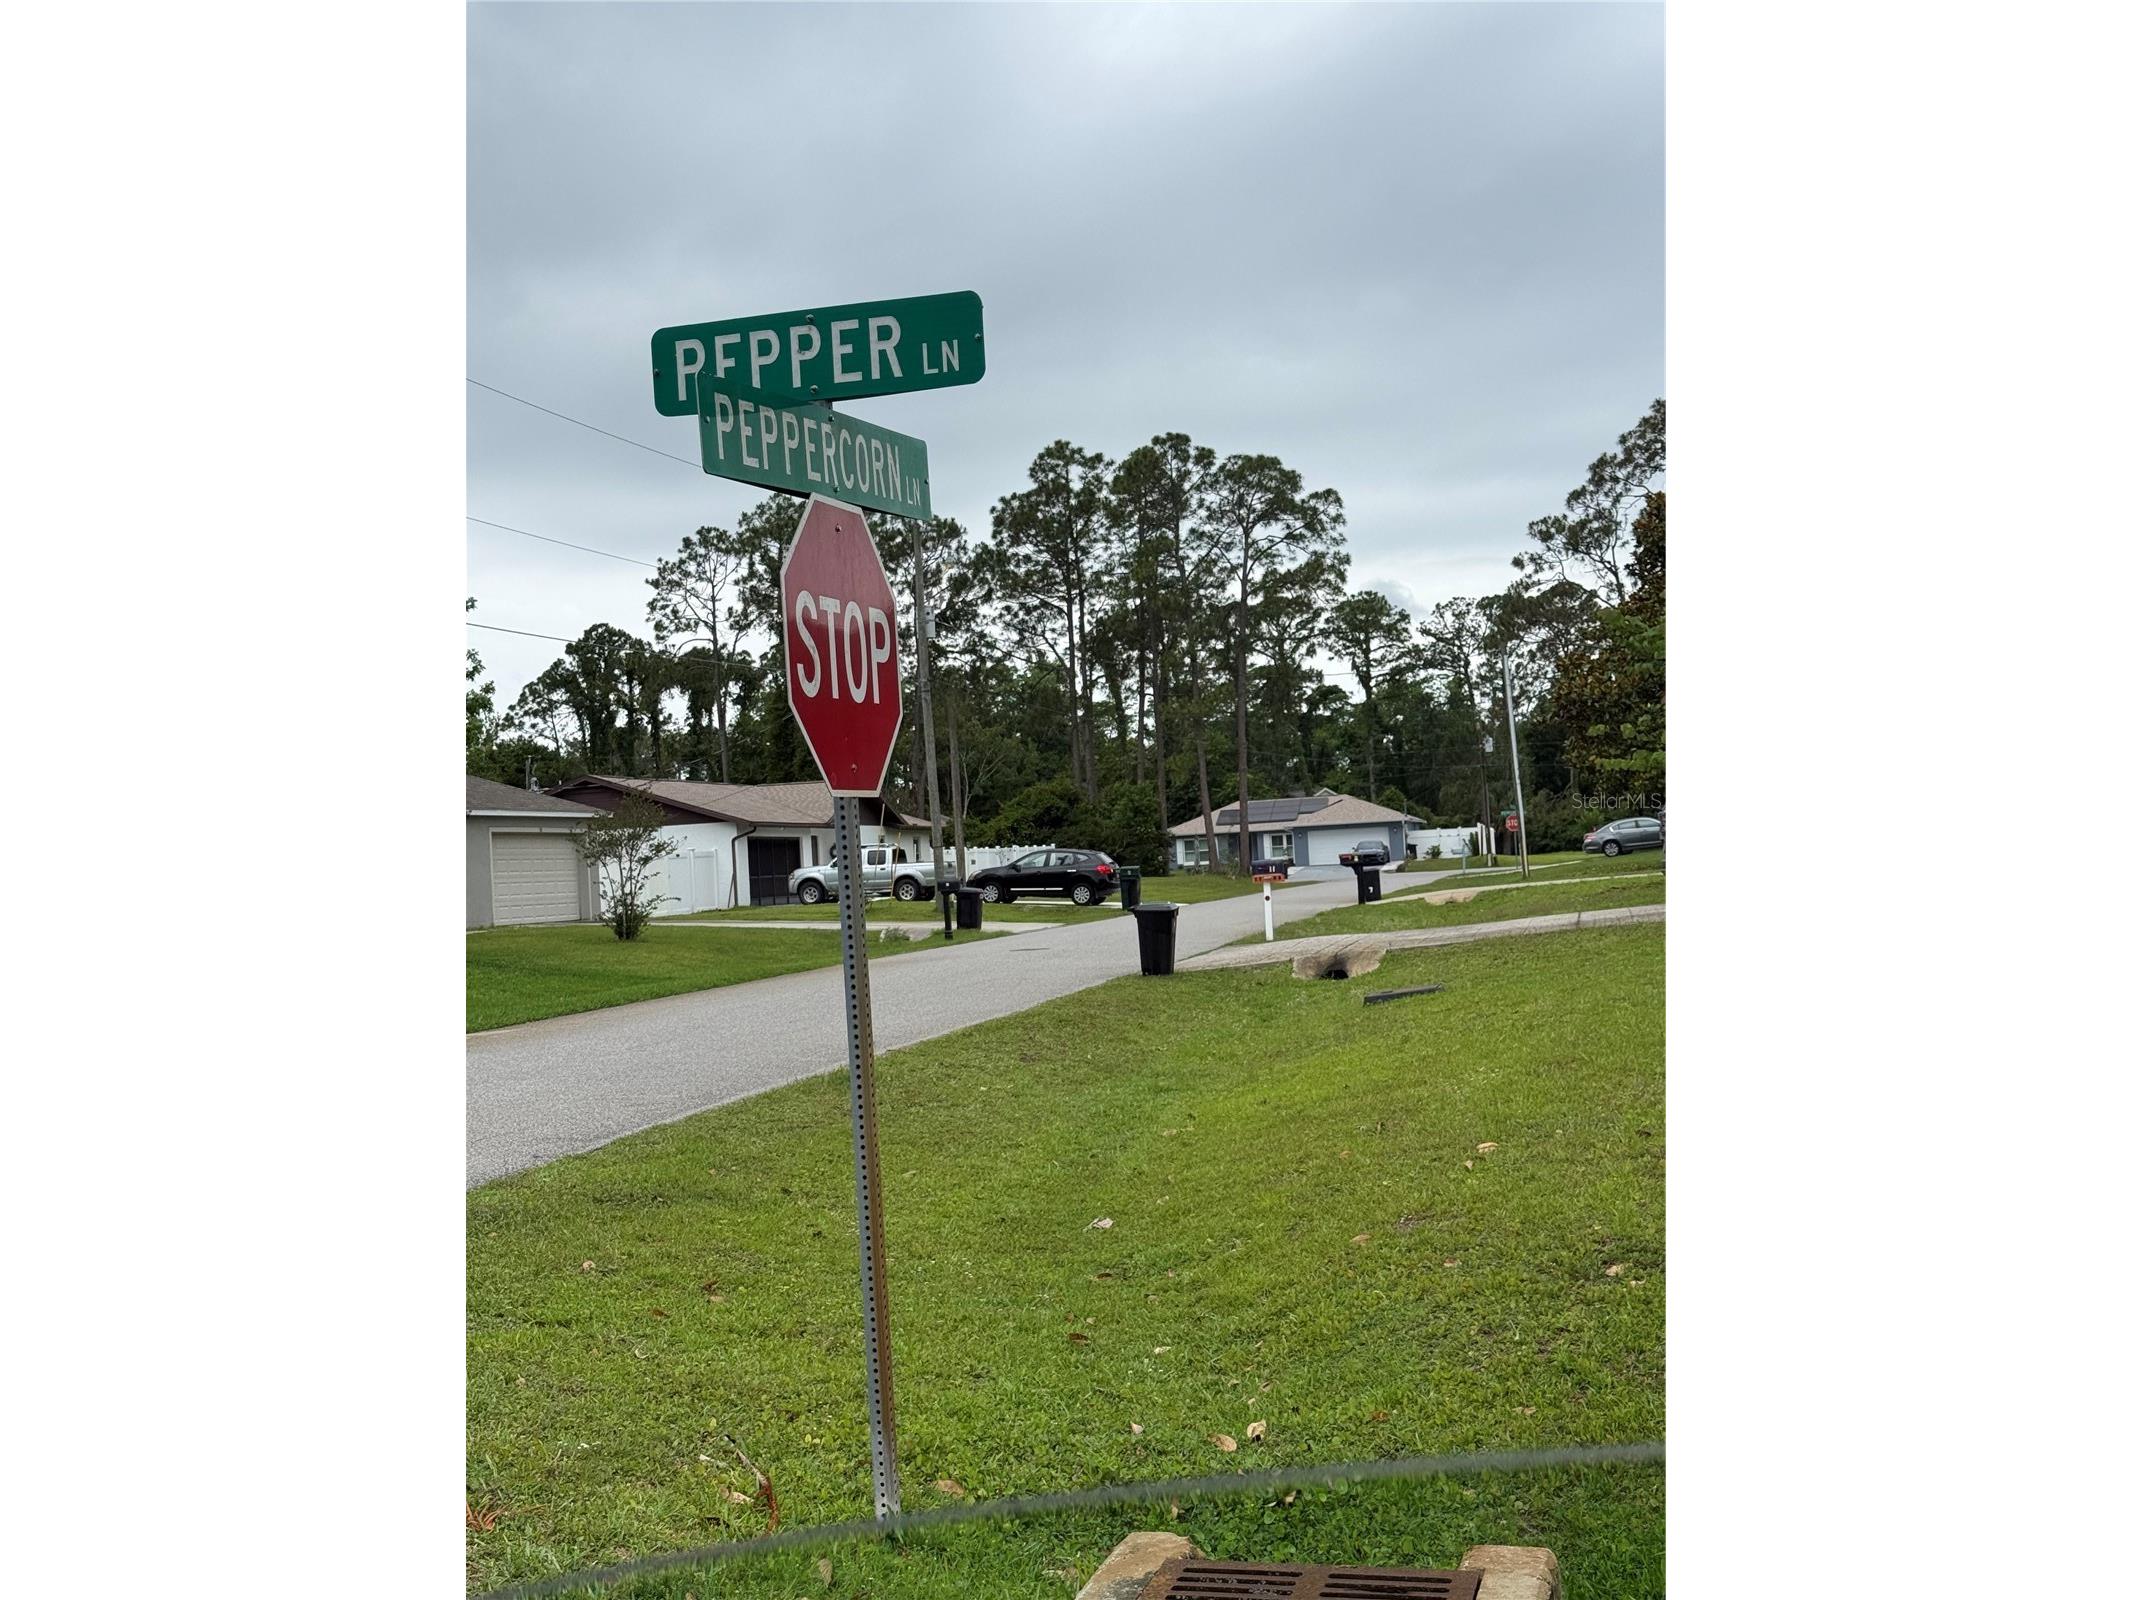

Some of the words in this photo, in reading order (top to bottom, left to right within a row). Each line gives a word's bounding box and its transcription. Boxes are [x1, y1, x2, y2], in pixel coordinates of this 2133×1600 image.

[675, 316, 903, 401] PEPPER
[922, 339, 960, 375] LN
[714, 391, 902, 502] PEPPERCORN
[906, 477, 921, 506] LN
[796, 590, 891, 705] STOP
